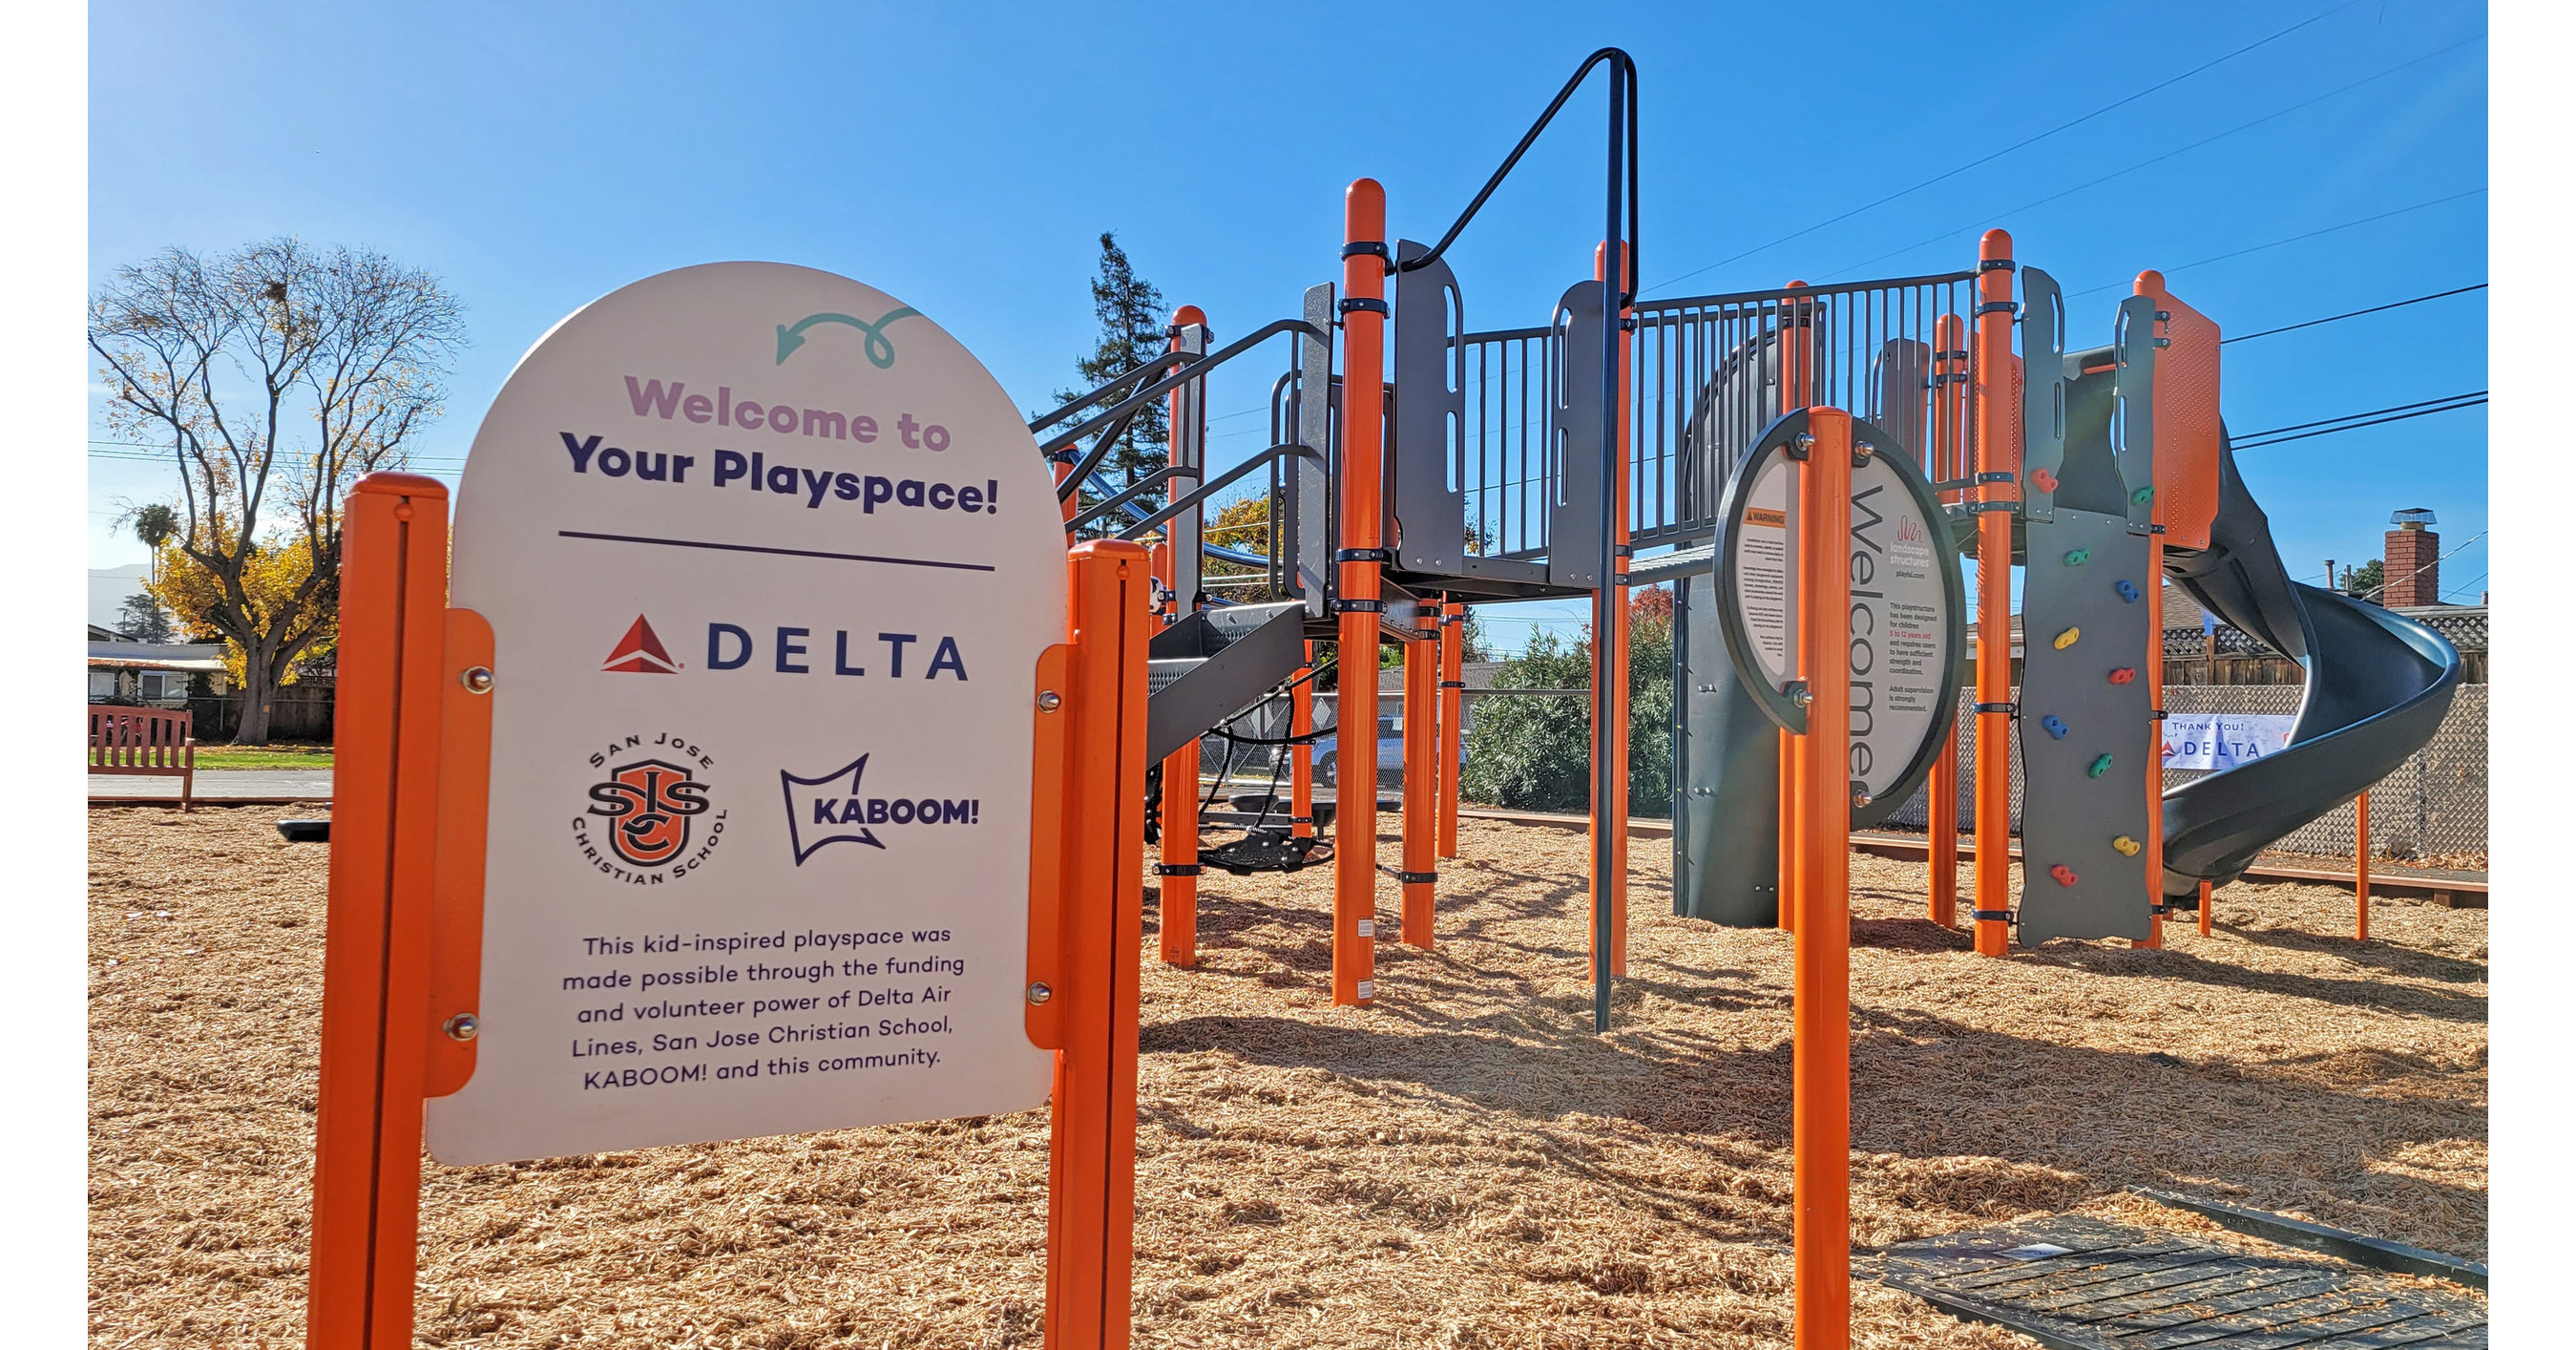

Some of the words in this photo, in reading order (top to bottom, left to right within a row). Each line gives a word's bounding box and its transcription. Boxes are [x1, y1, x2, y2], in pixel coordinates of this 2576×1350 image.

[624, 375, 879, 444] Welcome
[897, 412, 951, 453] to
[559, 431, 695, 484] Your
[713, 449, 998, 515] Playspace!
[1753, 512, 1785, 524] WARNING
[1890, 541, 1929, 557] landscape
[1890, 555, 1929, 567] structures
[1901, 603, 1936, 612] playstructure
[1914, 613, 1937, 622] designed
[1850, 484, 1884, 777] Welcome
[708, 622, 969, 682] DELTA
[1910, 649, 1934, 658] sufficient
[2172, 722, 2211, 730] THANK
[2216, 722, 2244, 731] YOU!
[589, 734, 642, 770] SAN
[654, 731, 715, 770] JOSE
[2184, 741, 2259, 758] DELTA
[813, 798, 979, 825] KABOOM!
[573, 816, 664, 886] CHRISTIAN
[672, 809, 728, 879] SCHOOL
[583, 936, 634, 956] This
[643, 930, 785, 956] kid-inspired
[794, 929, 904, 953] playspace
[911, 929, 951, 943] was
[563, 969, 632, 990] made
[641, 964, 739, 992] possible
[746, 960, 834, 983] through
[842, 959, 878, 977] the
[885, 955, 964, 977] funding
[577, 1002, 623, 1023] and
[634, 1000, 745, 1020] volunteer
[753, 997, 821, 1018] power
[827, 990, 851, 1008] of
[858, 987, 913, 1007] Delta
[921, 985, 952, 1003] Air
[573, 1038, 643, 1060] Lines,
[653, 1033, 698, 1052] San
[706, 1030, 760, 1048] Jose
[768, 1022, 869, 1044] Christian
[878, 1015, 953, 1037] School,
[584, 1064, 707, 1090] KABOOM!
[716, 1059, 759, 1080] and
[766, 1056, 809, 1076] this
[818, 1047, 940, 1072] community.
